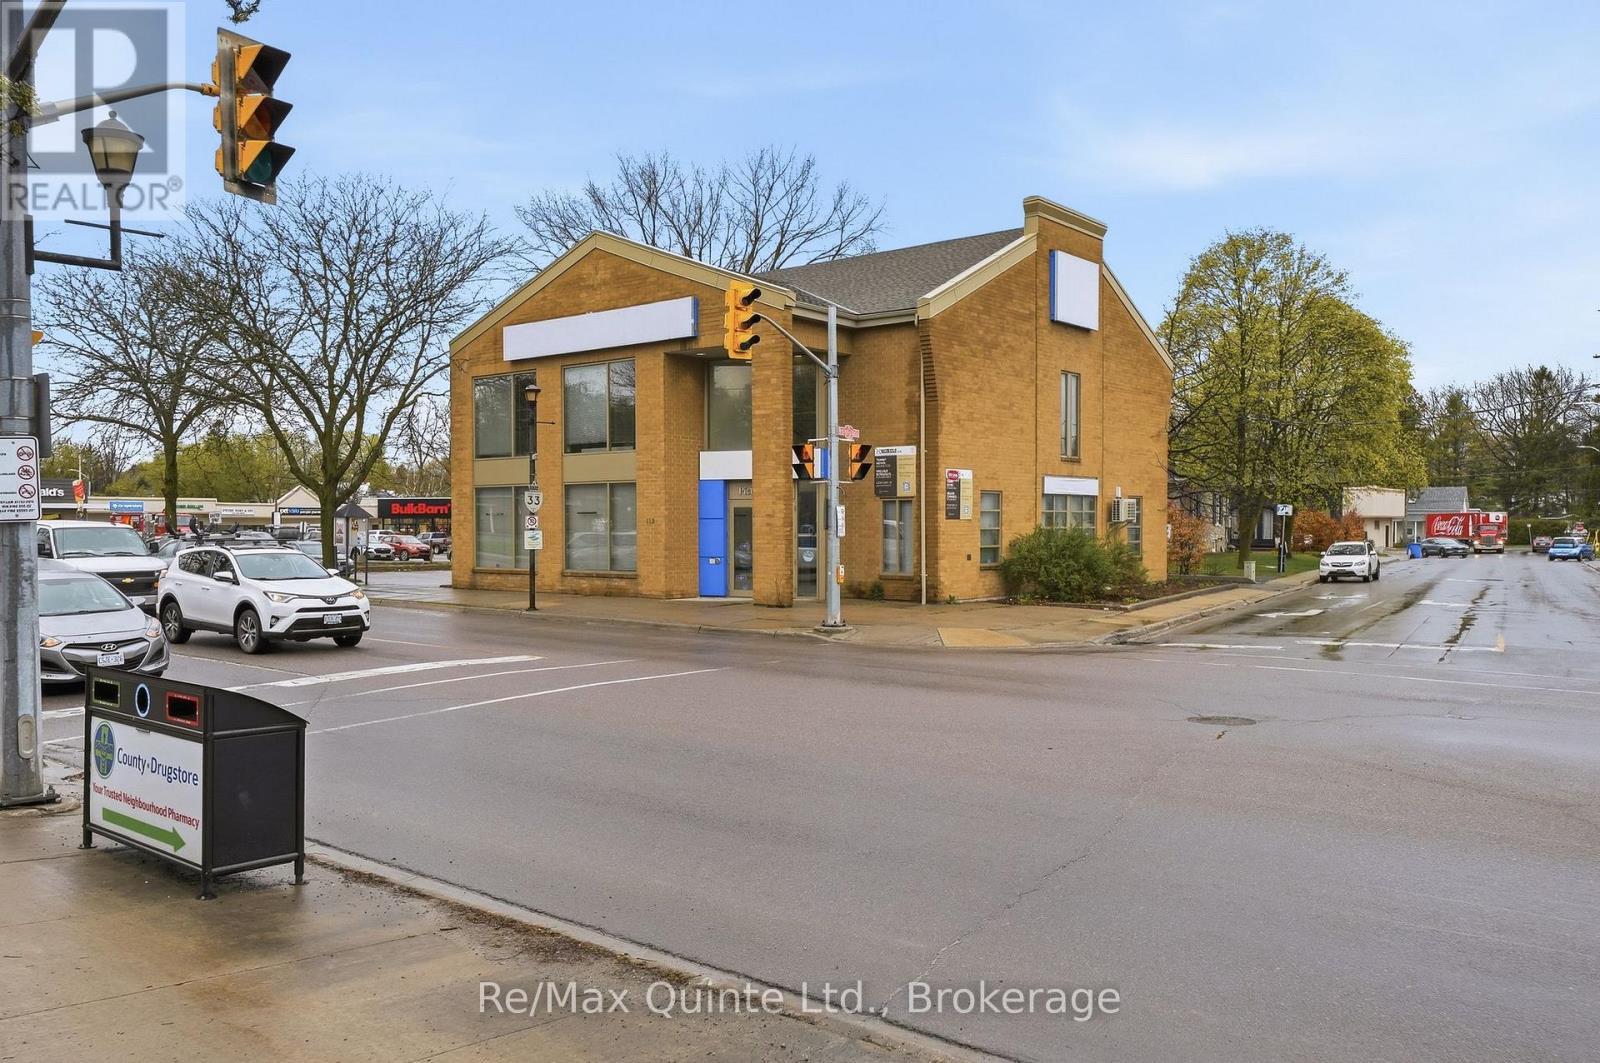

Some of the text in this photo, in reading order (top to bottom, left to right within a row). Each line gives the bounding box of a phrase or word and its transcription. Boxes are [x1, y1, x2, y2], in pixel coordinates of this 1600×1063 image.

[527, 495, 541, 506] 33
[92, 782, 200, 830] Your Trusted Neighbourhood Pharmacy
